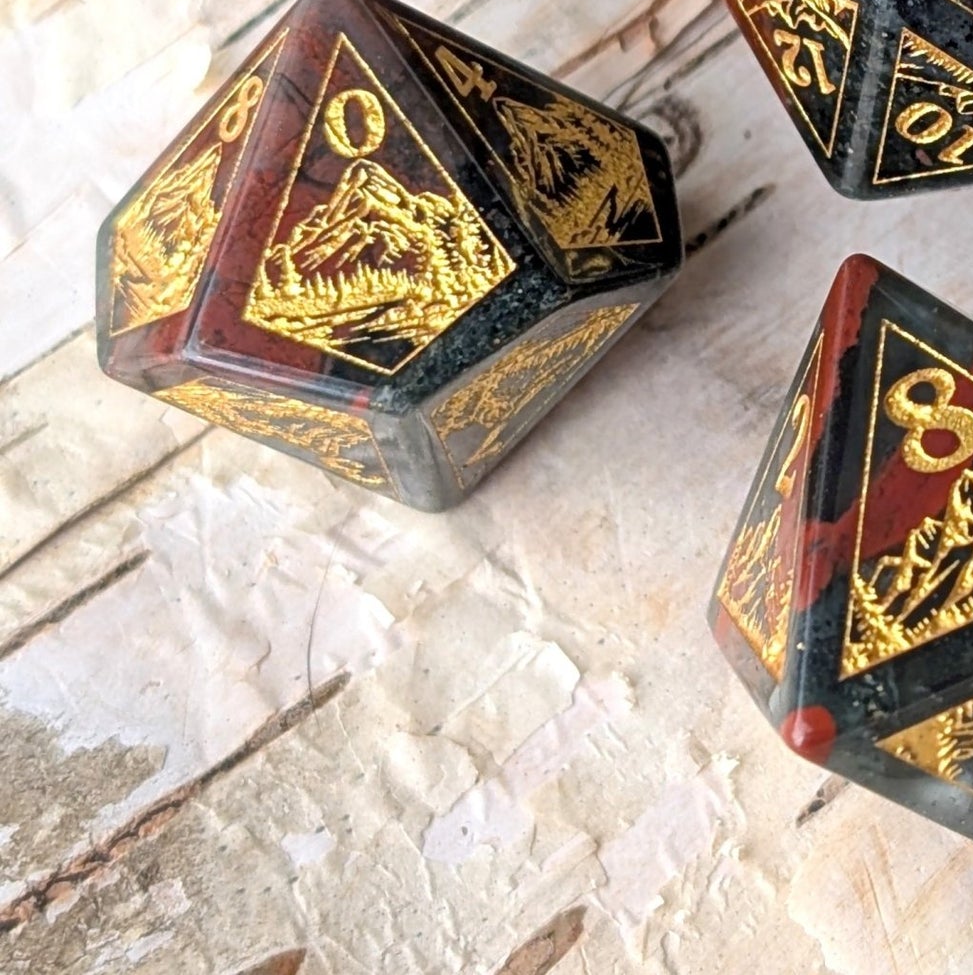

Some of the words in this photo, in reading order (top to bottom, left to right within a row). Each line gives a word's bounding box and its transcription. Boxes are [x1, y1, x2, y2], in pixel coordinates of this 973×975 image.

[435, 44, 498, 103] 4
[774, 28, 836, 96] 12
[218, 76, 265, 144] 8
[323, 89, 386, 158] 0
